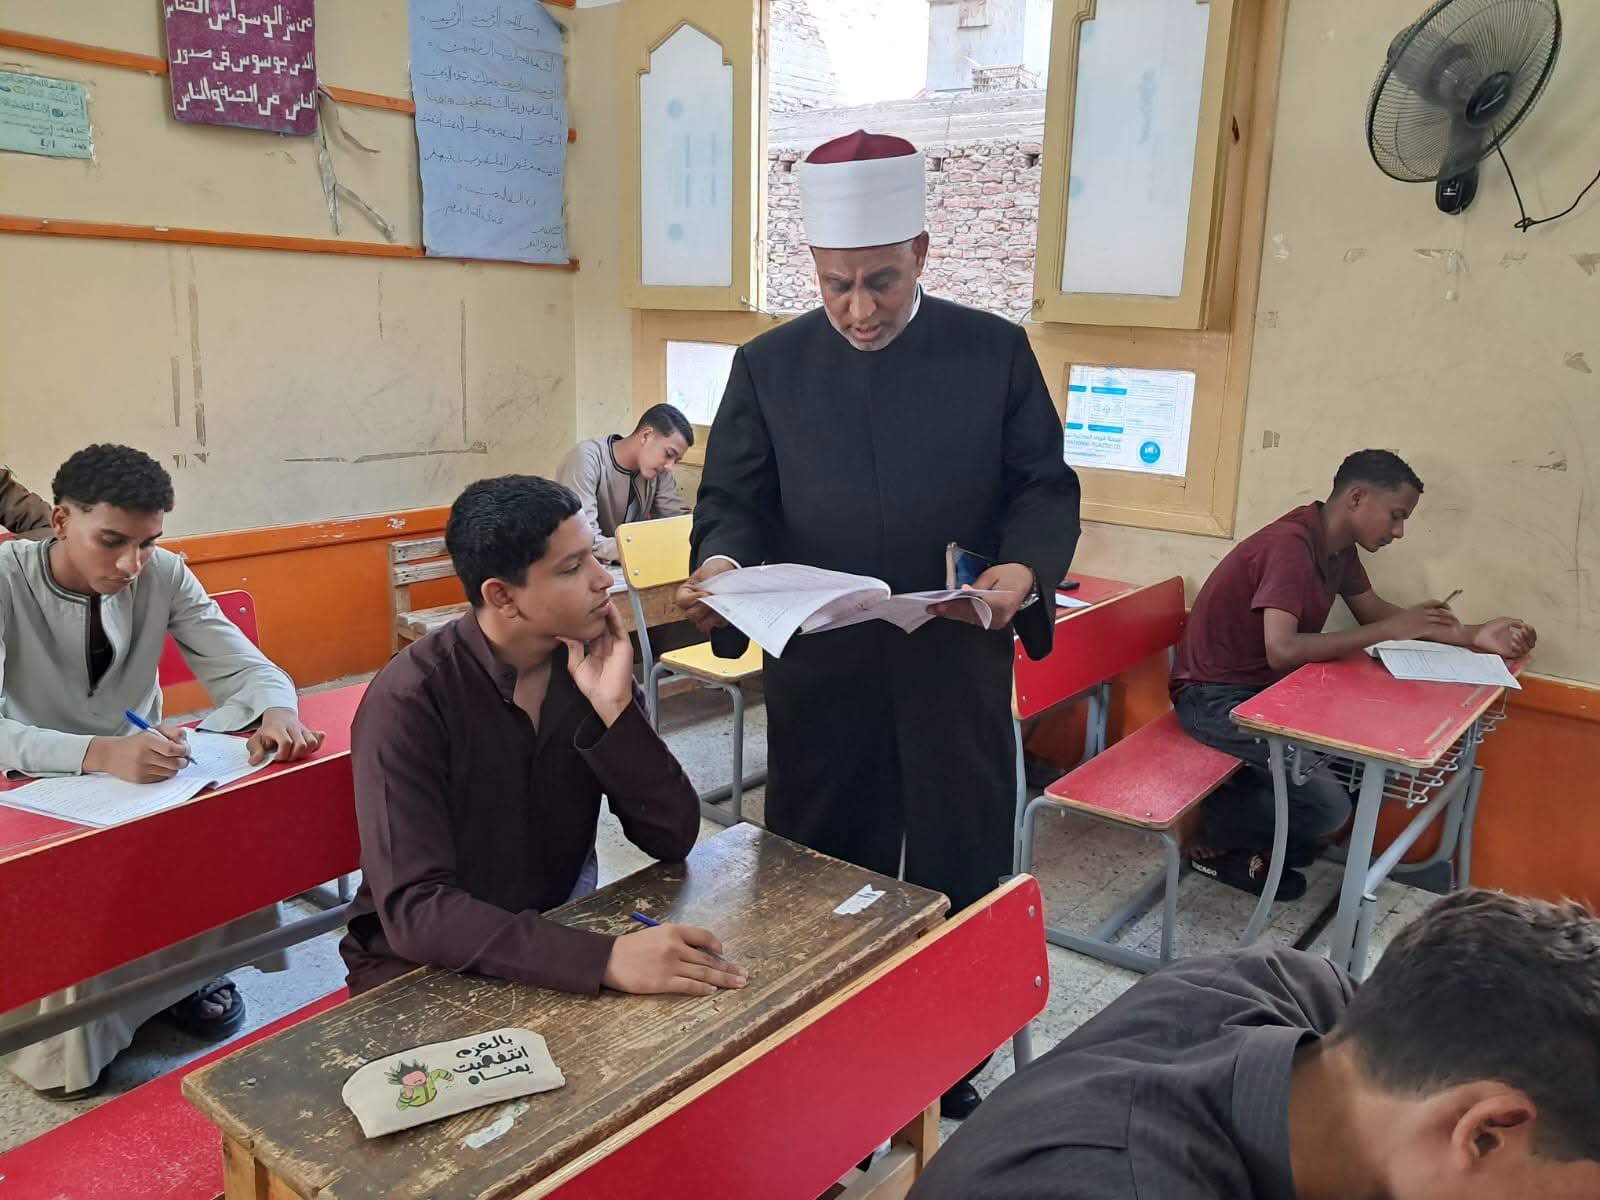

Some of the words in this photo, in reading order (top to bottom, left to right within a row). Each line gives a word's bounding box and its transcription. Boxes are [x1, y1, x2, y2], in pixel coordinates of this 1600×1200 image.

[173, 48, 212, 64] صدور
[231, 54, 288, 75] يوسوس
[456, 1034, 513, 1059] بالعزم
[468, 1063, 534, 1085] يمناه
